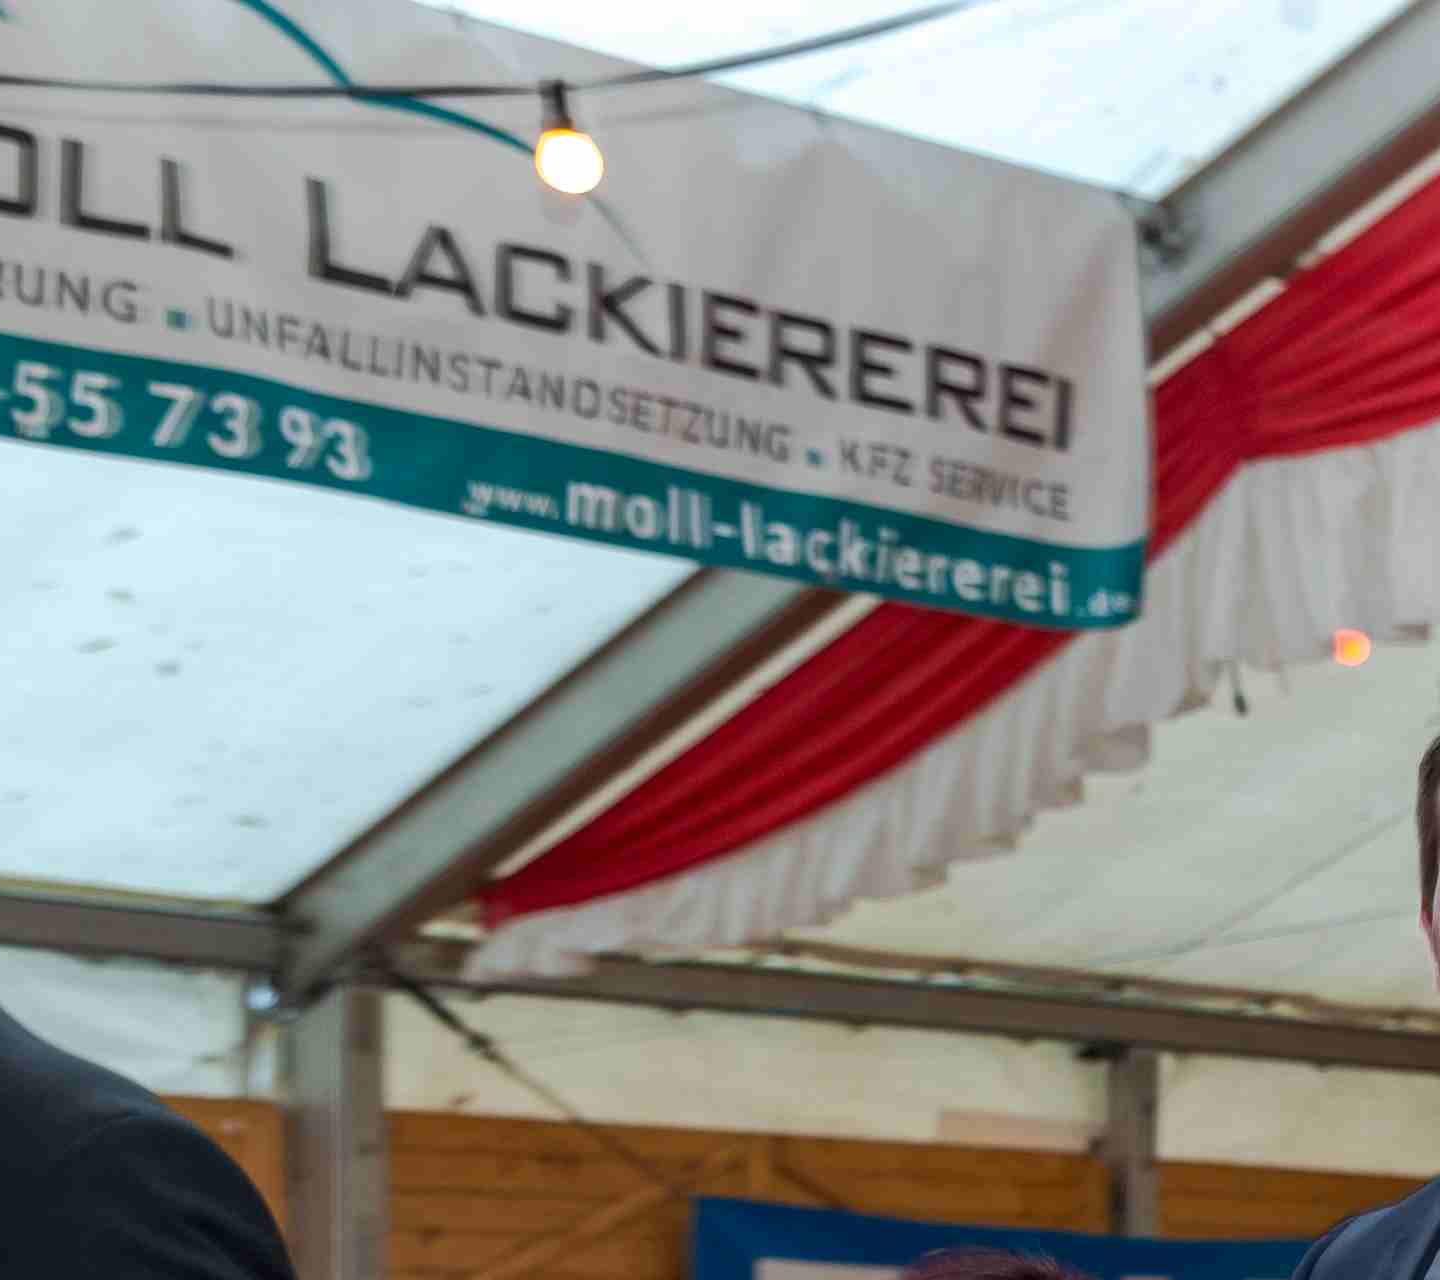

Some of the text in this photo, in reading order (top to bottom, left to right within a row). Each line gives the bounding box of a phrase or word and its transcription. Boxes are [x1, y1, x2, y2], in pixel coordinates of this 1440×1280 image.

[205, 296, 791, 463] UNFALLINSTANDSETZUNG
[839, 435, 912, 488] KFZ
[928, 454, 1071, 522] SERVICE
[306, 176, 1074, 452] LACKIEREREI
[147, 379, 262, 460] 73
[277, 403, 374, 482] 93
